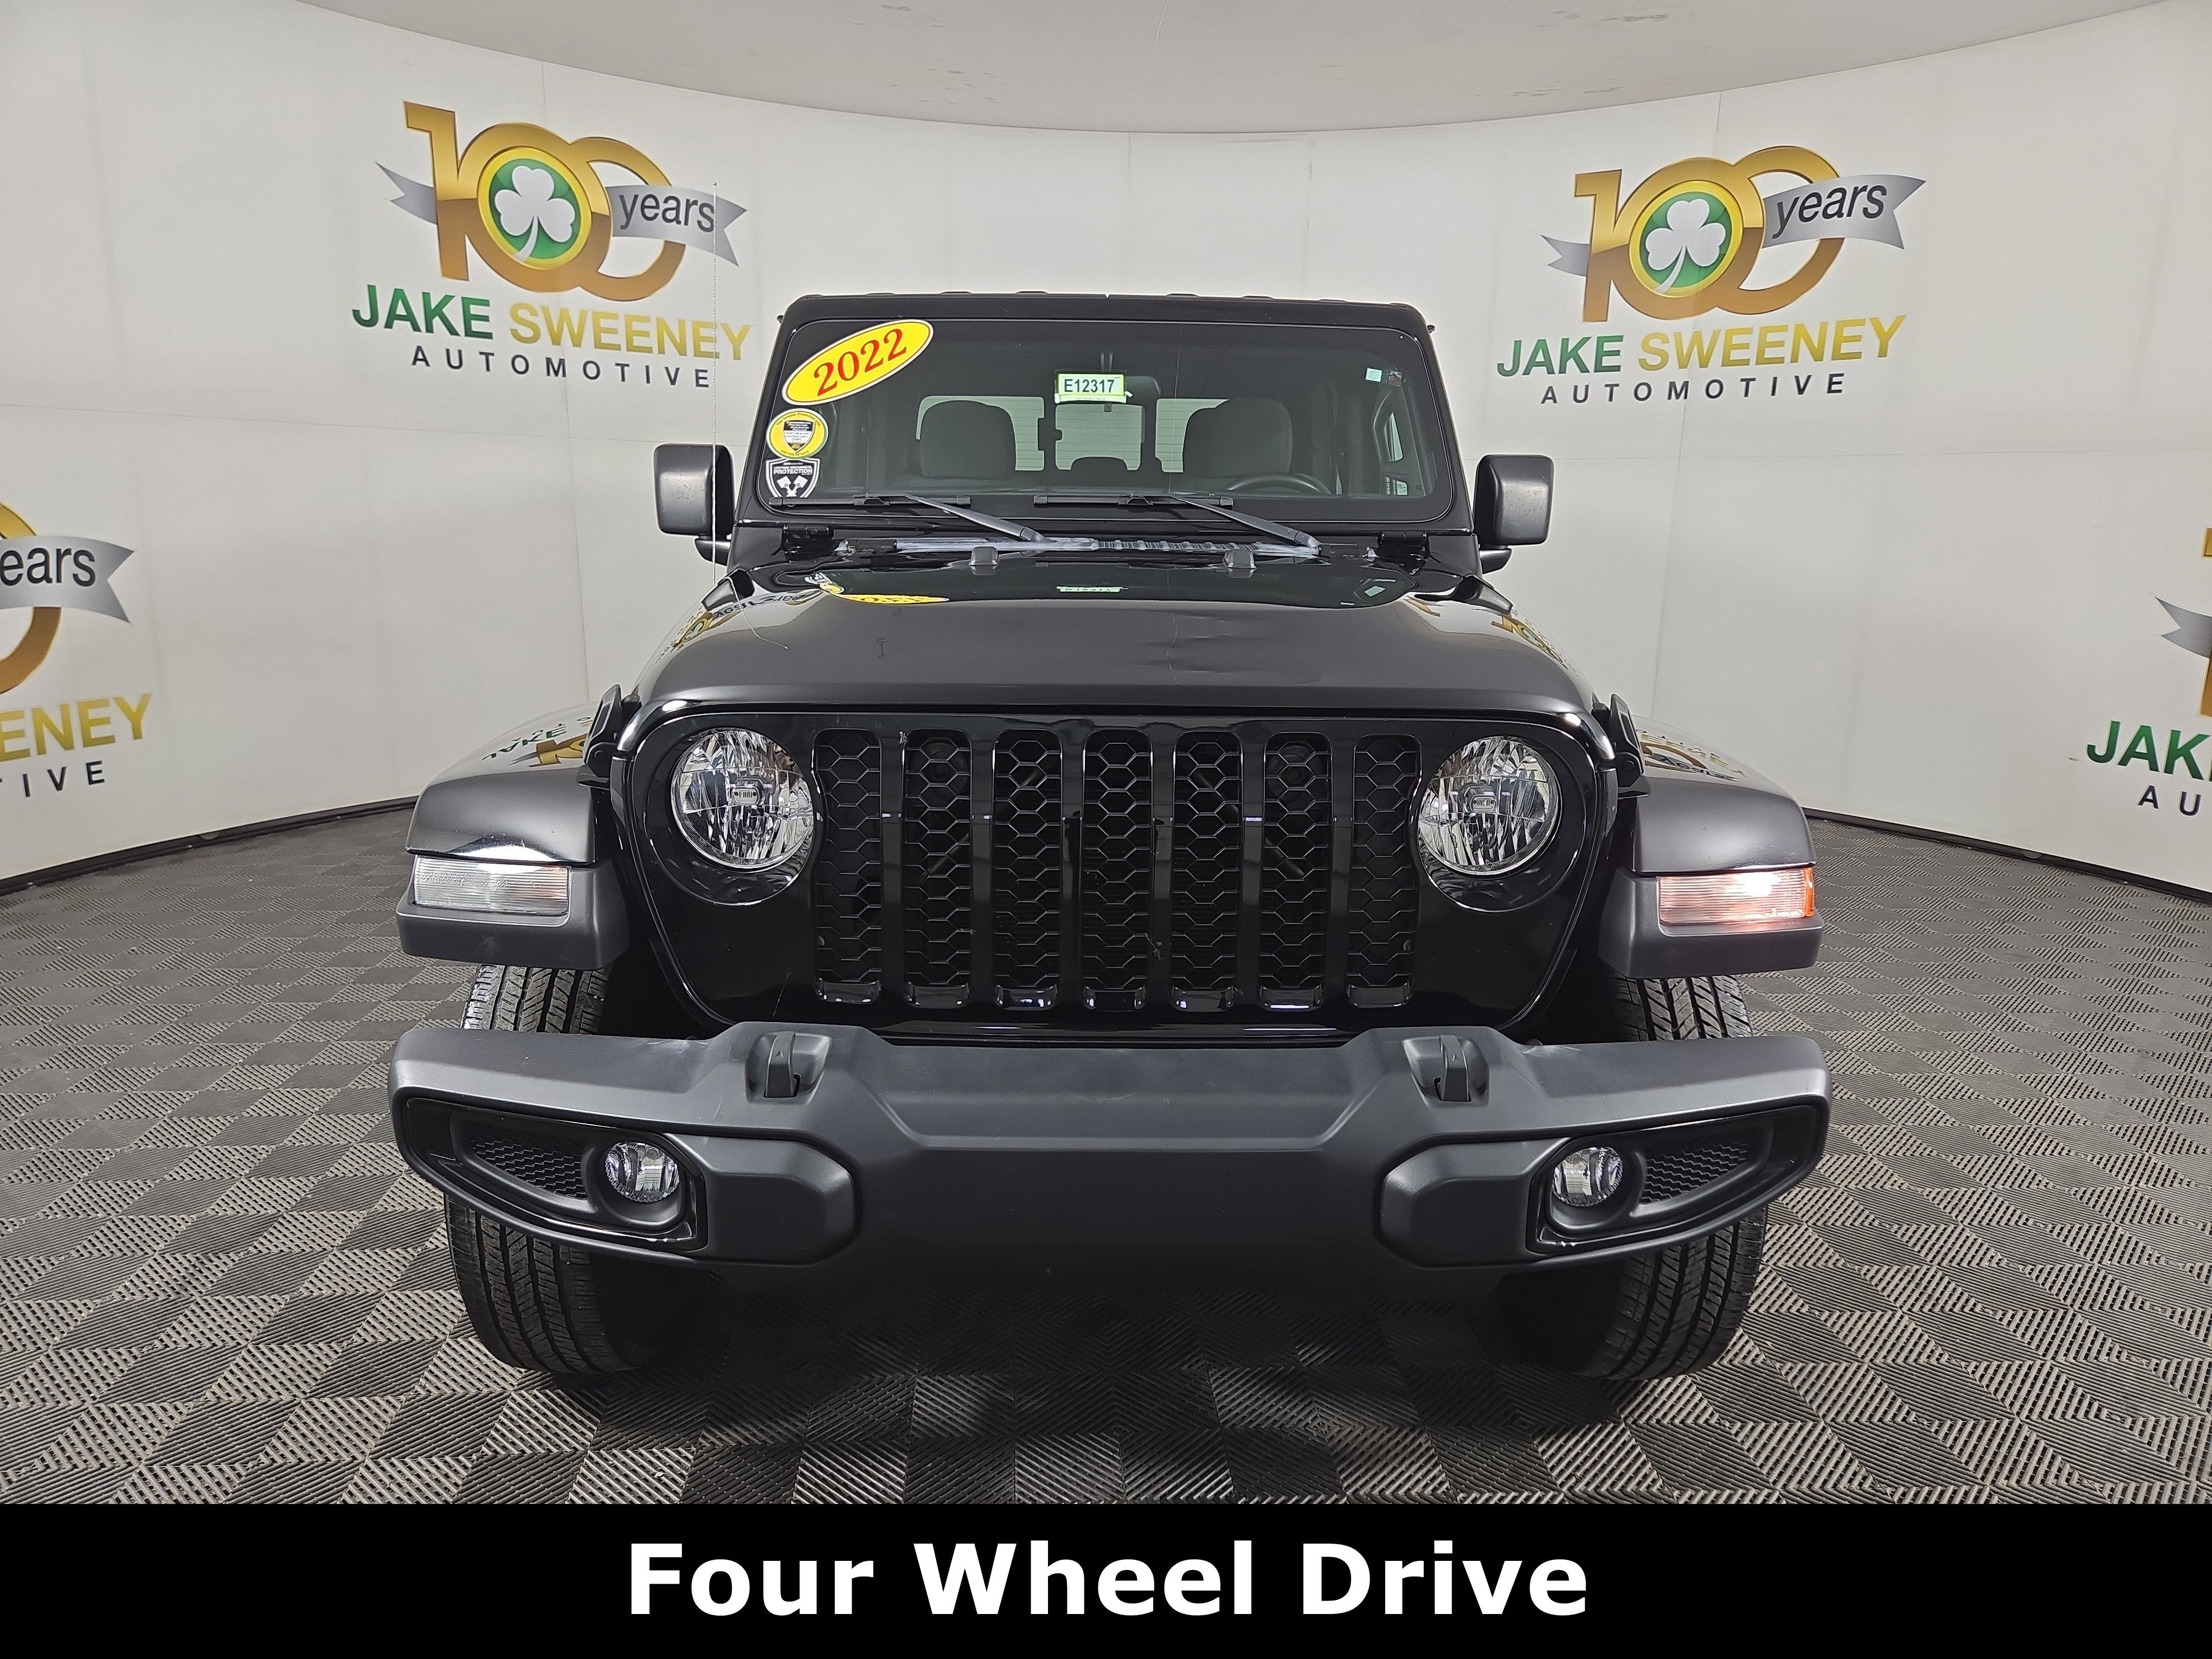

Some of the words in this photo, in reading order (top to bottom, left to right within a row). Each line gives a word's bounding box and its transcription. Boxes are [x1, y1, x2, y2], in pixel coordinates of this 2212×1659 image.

[619, 192, 716, 232] years
[1773, 183, 1887, 239] years
[352, 284, 494, 340] JAKE
[509, 302, 755, 361] SWEENEY
[411, 345, 710, 388] AUTOMOTIVE
[813, 328, 907, 396] 2022
[1497, 335, 1624, 377] JAKE
[1638, 314, 1907, 372] SWEENEY
[1064, 378, 1115, 393] E12317
[1541, 372, 1845, 405] AUTOMOTIVE
[0, 547, 96, 587] ears
[2086, 720, 2212, 782] JAK
[0, 761, 106, 798] IVE
